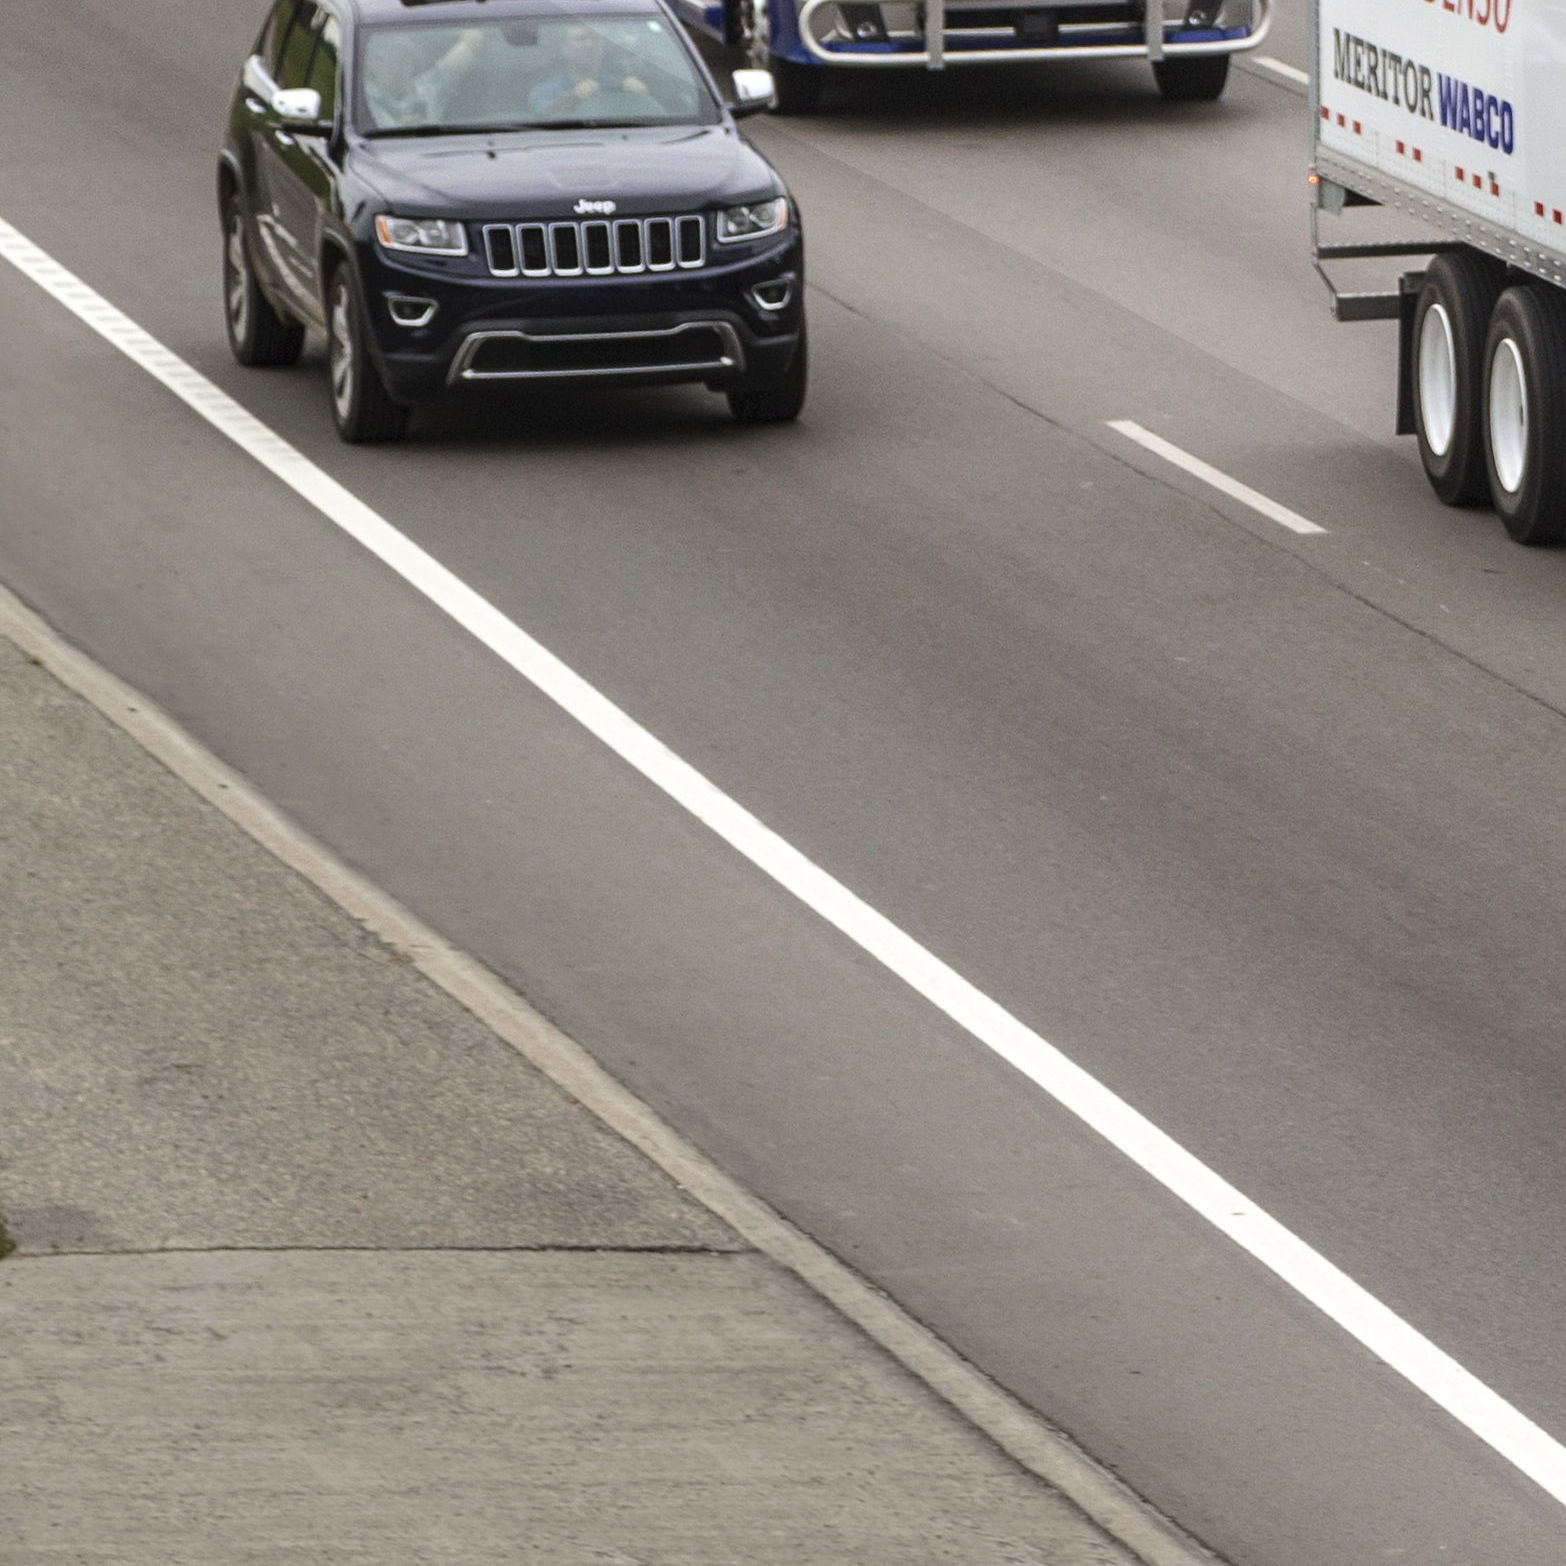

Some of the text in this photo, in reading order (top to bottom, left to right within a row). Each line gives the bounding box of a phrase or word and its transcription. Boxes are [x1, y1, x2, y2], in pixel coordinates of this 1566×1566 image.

[1333, 26, 1514, 156] MERITOR WABCO
[573, 198, 616, 215] Jeep
